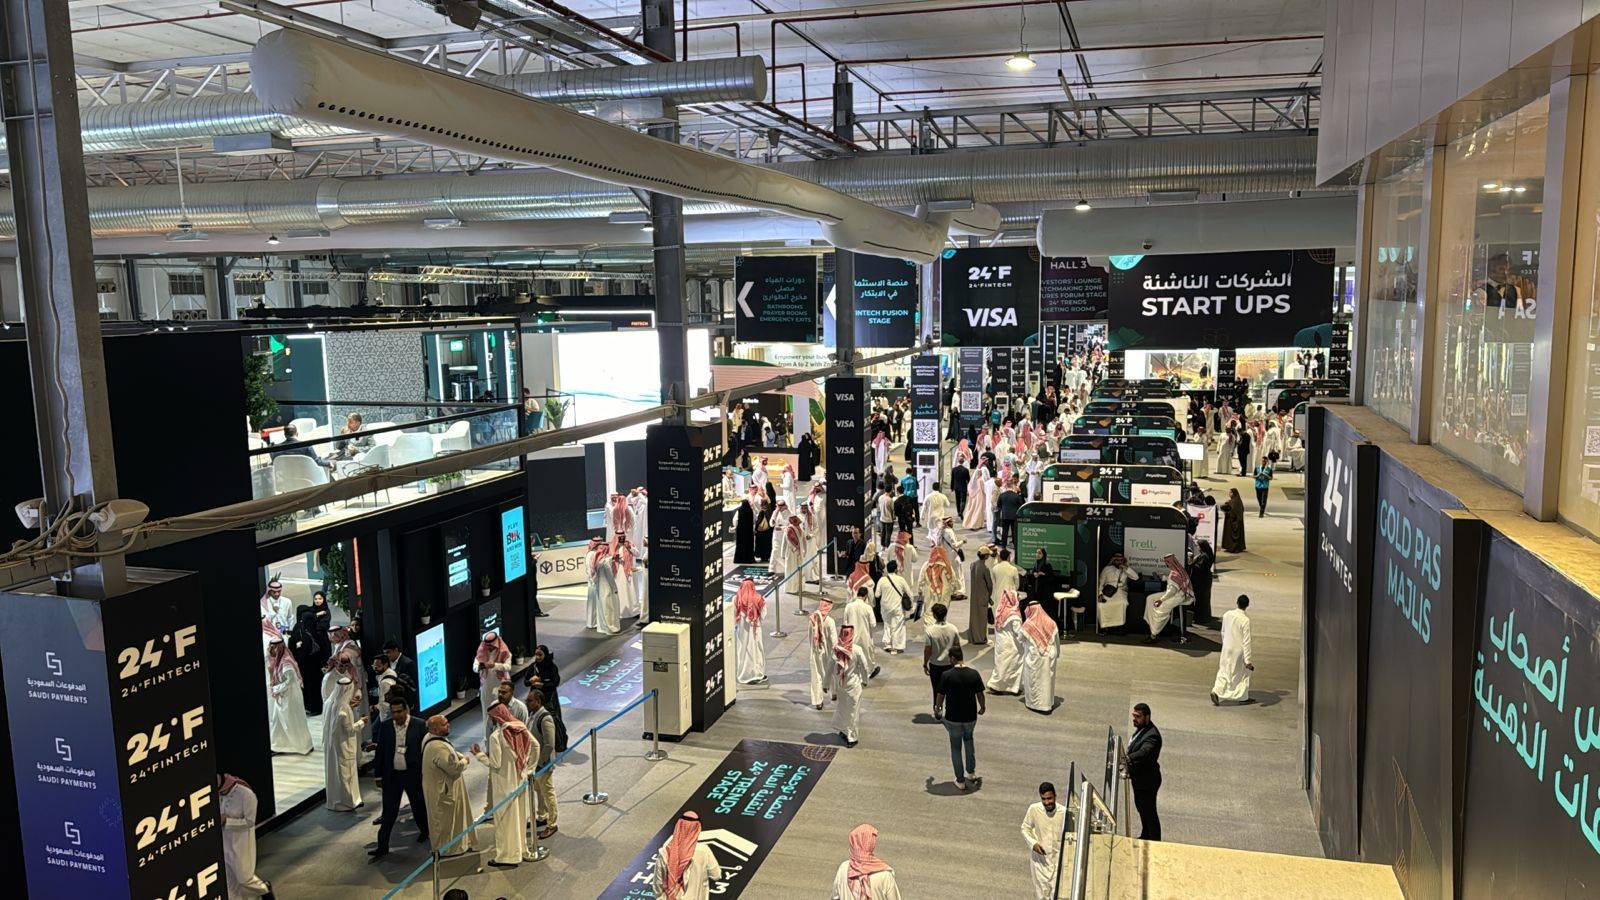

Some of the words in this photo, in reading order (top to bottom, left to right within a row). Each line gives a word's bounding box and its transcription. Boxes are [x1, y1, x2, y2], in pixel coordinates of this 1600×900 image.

[1050, 261, 1078, 270] HALL
[1080, 260, 1087, 269] 3
[854, 279, 885, 287] الاستثما
[886, 279, 909, 287] منصة
[1143, 272, 1208, 291] الناشئة
[1216, 270, 1292, 292] الشركات
[861, 290, 886, 299] الابتكار
[887, 290, 898, 301] في
[1141, 295, 1227, 317] START
[1235, 294, 1291, 315] UPS
[962, 307, 1018, 327] VISA
[835, 393, 855, 402] VISA
[835, 419, 855, 428] VISA
[835, 446, 855, 454] VISA
[836, 472, 856, 480] VISA
[836, 498, 856, 507] VISA
[1379, 498, 1411, 559] GOLD
[1414, 526, 1441, 592] PAS
[555, 556, 585, 573] BSF
[1321, 530, 1352, 594] 24°FINTEC
[1387, 557, 1432, 645] MAJLIS
[1490, 607, 1570, 714] أصحاب
[27, 677, 55, 689] السعودية
[121, 659, 201, 698] 24°FINTECH
[55, 680, 87, 692] المدفوعات
[611, 683, 633, 694] VIP
[28, 690, 50, 700] SAUDI
[51, 692, 88, 704] PAYMENTS
[1474, 650, 1547, 783] الذهبية
[36, 762, 64, 773] السعودية
[130, 740, 208, 784] 24°FINTECH
[65, 765, 96, 777] المدفوعات
[38, 774, 60, 785] SAUDI
[60, 777, 97, 789] PAYMENTS
[707, 770, 742, 799] STAGE
[714, 776, 756, 815] TRENDS
[138, 818, 216, 868] 24°FINTECH
[46, 845, 74, 856] السعودية
[74, 848, 105, 862] المدفوعات
[47, 856, 69, 867] SAUDI
[69, 860, 106, 873] PAYMENTS
